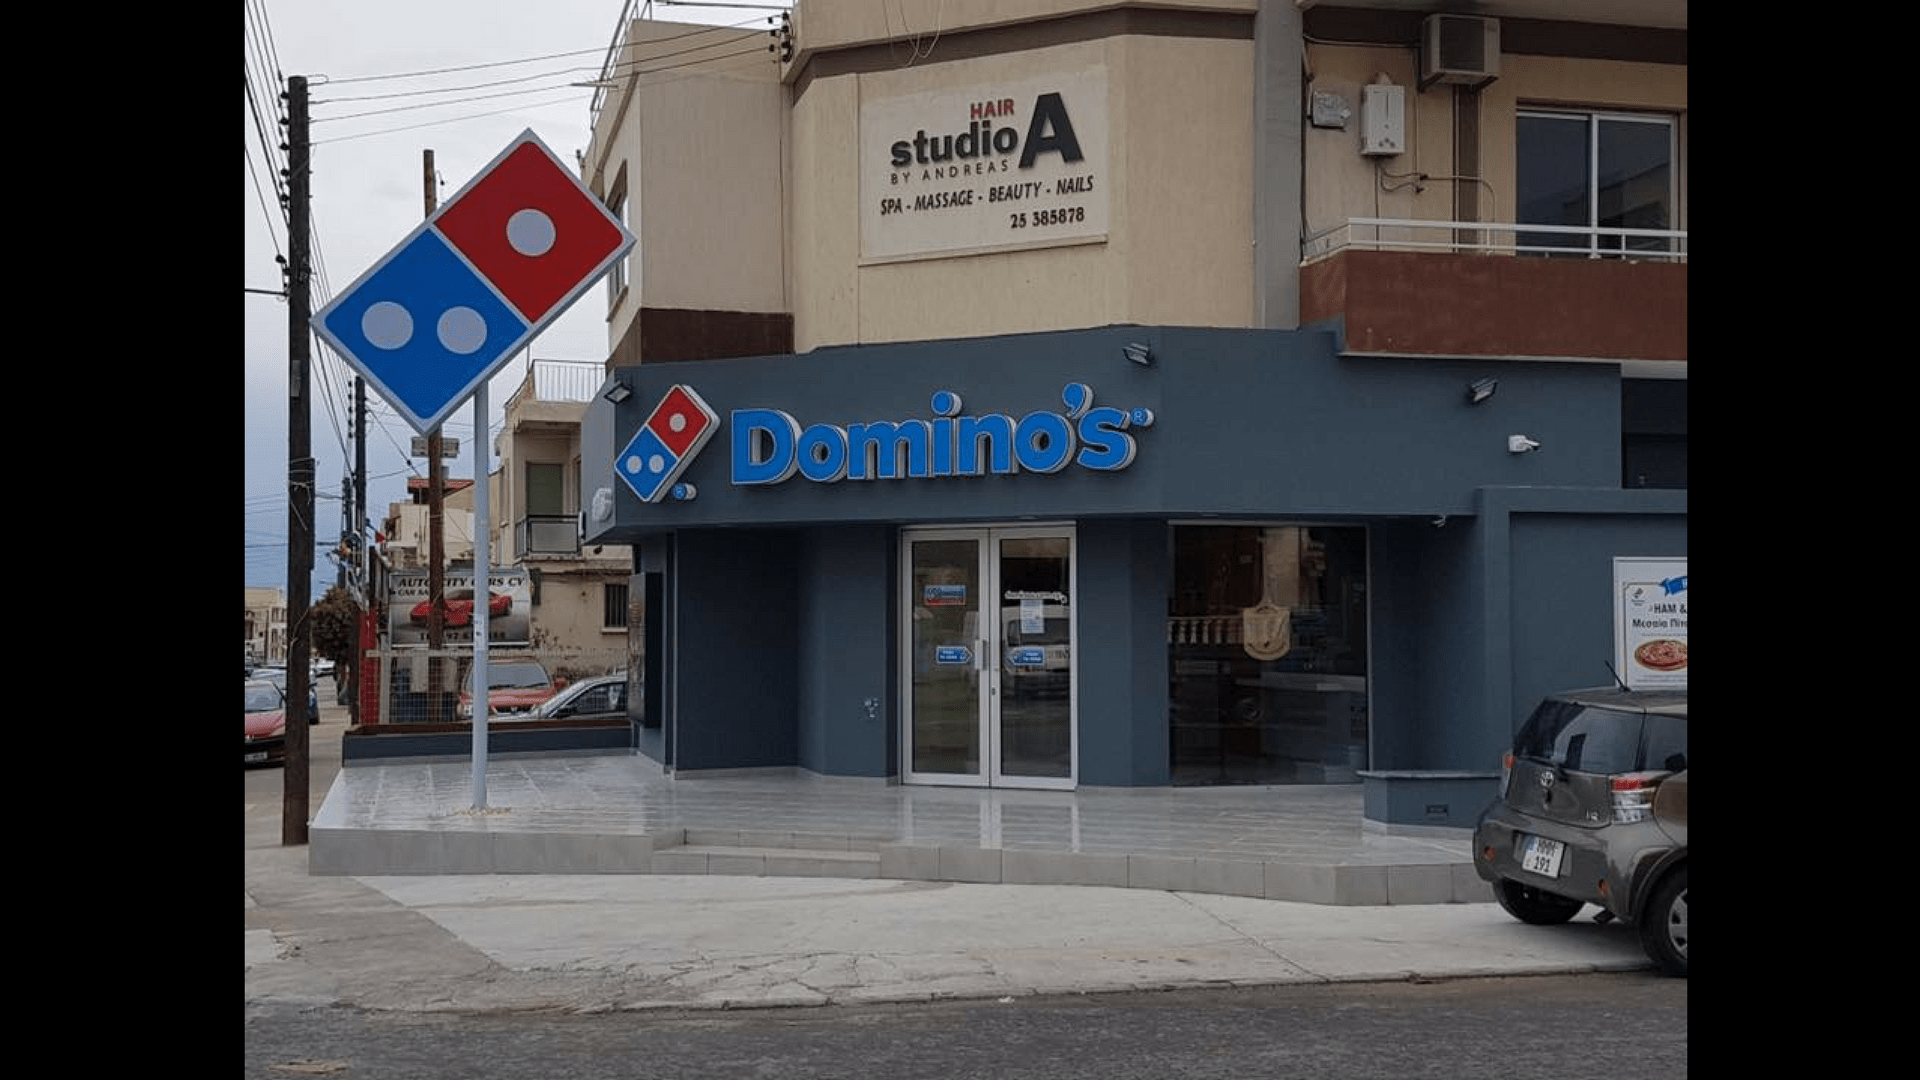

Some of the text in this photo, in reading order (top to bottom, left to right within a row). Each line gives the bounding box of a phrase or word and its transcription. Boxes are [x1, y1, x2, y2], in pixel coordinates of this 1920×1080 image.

[970, 98, 1015, 120] HAIR
[891, 92, 1085, 169] studio A
[890, 159, 1009, 185] BY ANDREAS
[880, 198, 903, 216] SPA
[914, 190, 974, 212] MASSAGE
[989, 181, 1042, 203] BEAUTY
[1056, 175, 1095, 195] NAILS
[1010, 207, 1085, 229] 25 385878
[730, 382, 1137, 484] Domino's
[1653, 603, 1677, 615] HAM
